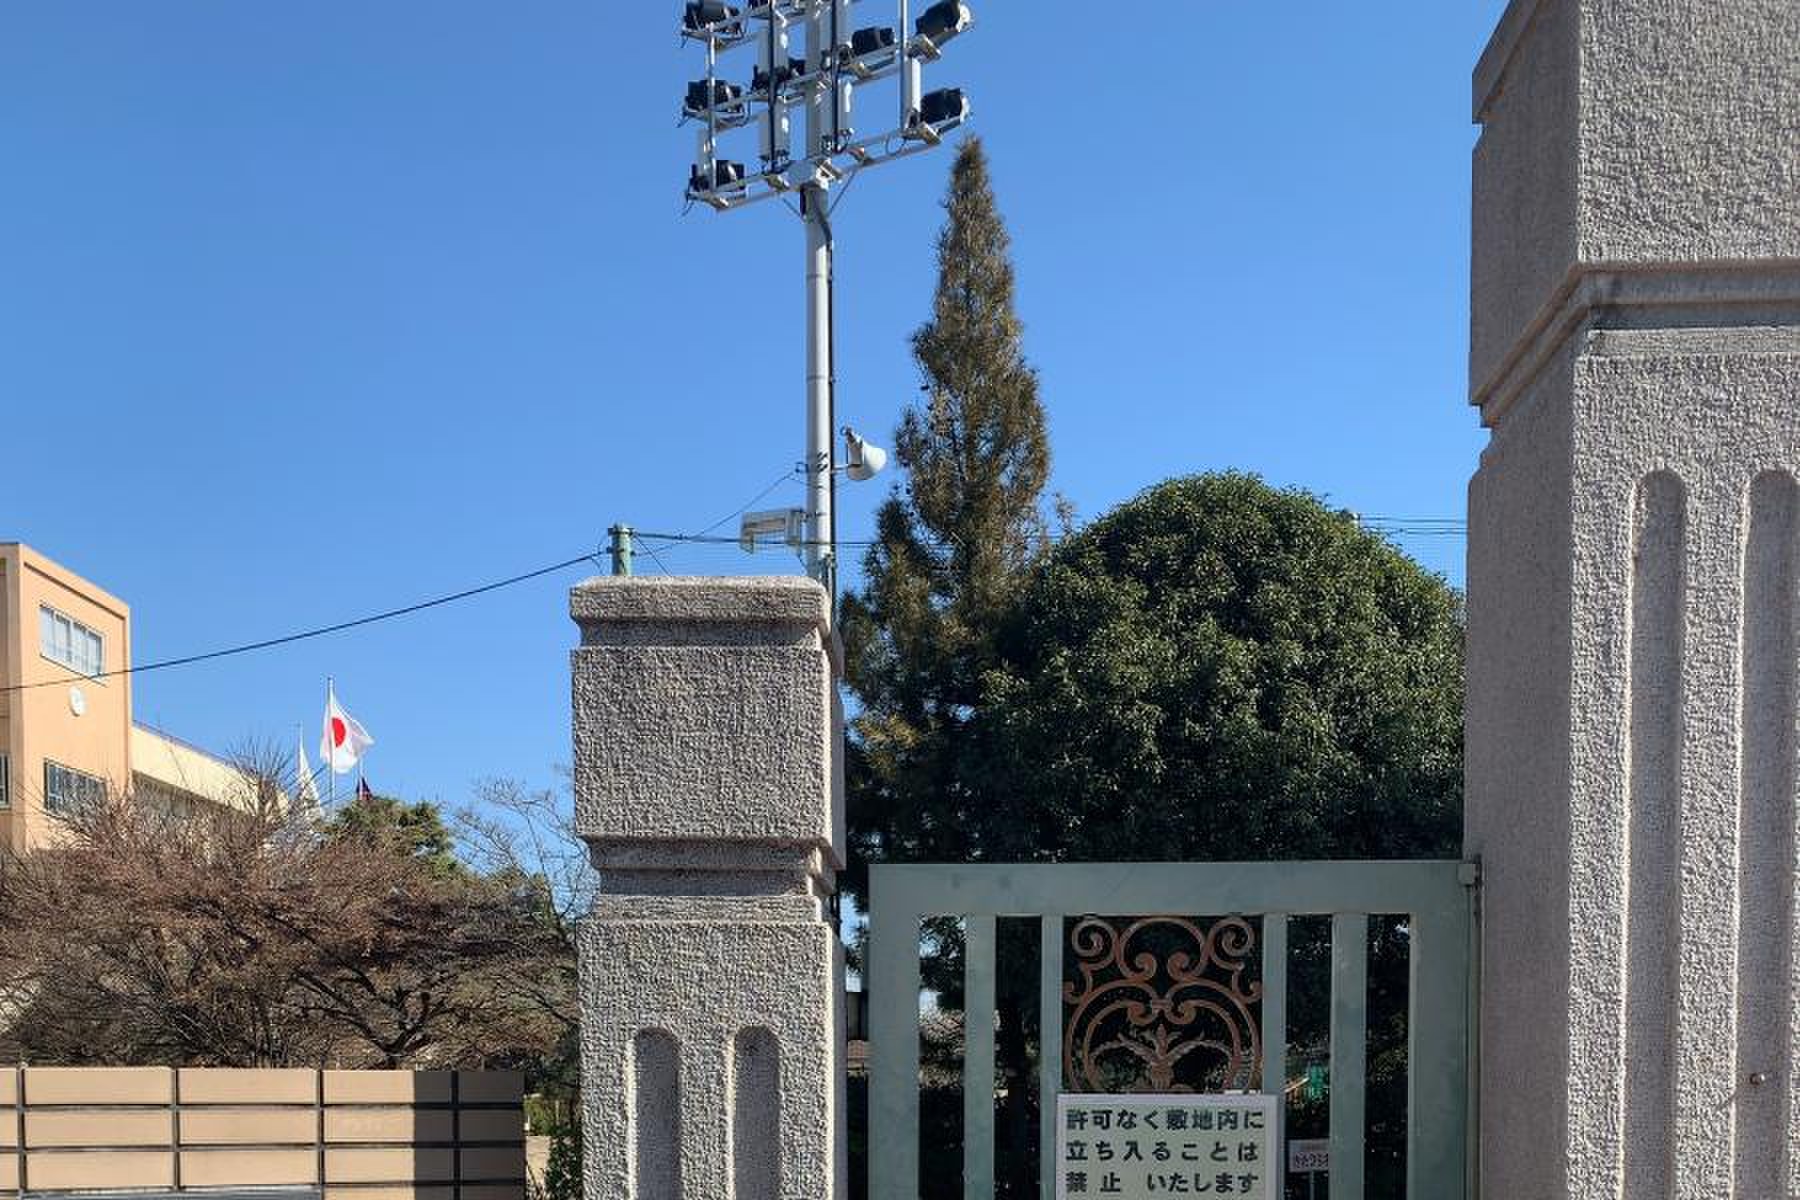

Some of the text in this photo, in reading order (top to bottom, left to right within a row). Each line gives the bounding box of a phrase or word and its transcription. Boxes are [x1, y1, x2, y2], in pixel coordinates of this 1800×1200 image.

[1066, 1109, 1265, 1131] 許可なく敷地内に
[1065, 1140, 1259, 1162] 立ち入ることは
